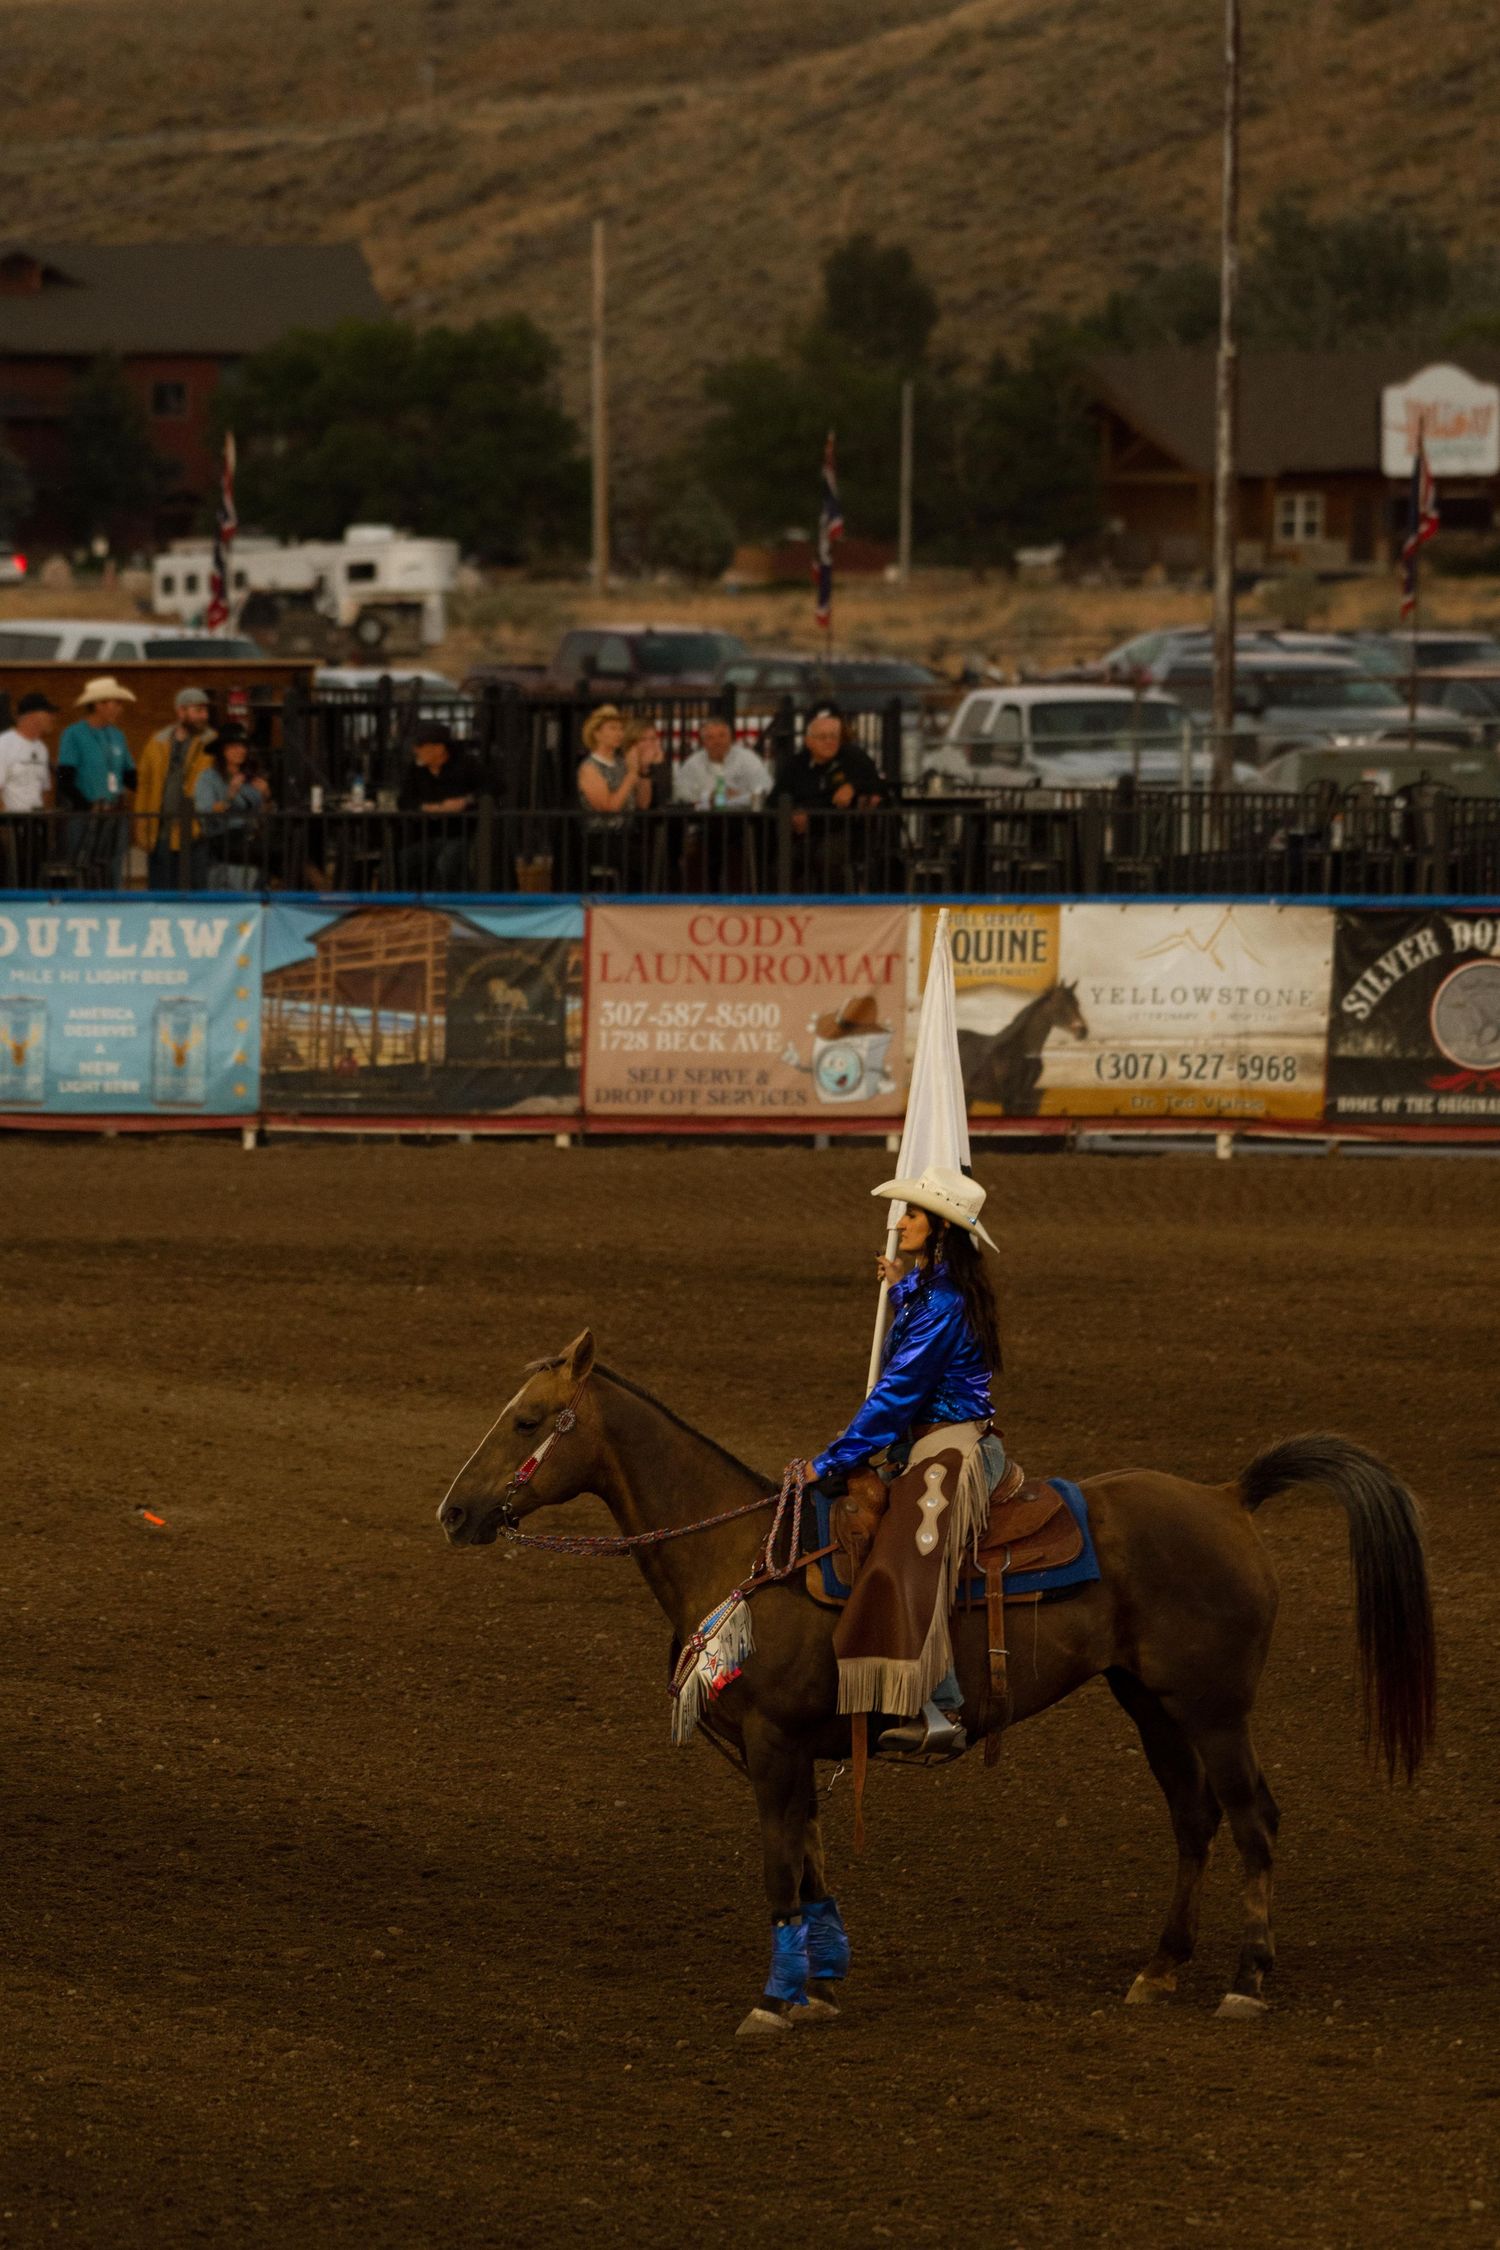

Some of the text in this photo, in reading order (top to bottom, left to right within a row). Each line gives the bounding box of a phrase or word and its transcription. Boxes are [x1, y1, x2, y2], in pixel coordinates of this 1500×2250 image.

[688, 914, 814, 948] CODY
[983, 912, 1036, 928] SERVICE
[0, 917, 229, 958] OUTLAW
[951, 929, 1047, 964] QUINE
[600, 952, 900, 986] LAUNDROMAT
[1341, 919, 1500, 1021] SILVER DO
[1090, 986, 1314, 1008] YELLOWSTONE
[600, 1001, 781, 1028] 307-587-8500
[600, 1031, 783, 1052] 1728 BECK AVE
[627, 1067, 676, 1084] SELF
[684, 1068, 750, 1085] SERVE
[1095, 1052, 1297, 1083] (307) 527-6968
[594, 1088, 808, 1107] DROP OFF SERVICES
[1337, 1097, 1378, 1113] HOME
[1381, 1097, 1401, 1113] OF
[1405, 1097, 1434, 1114] THE
